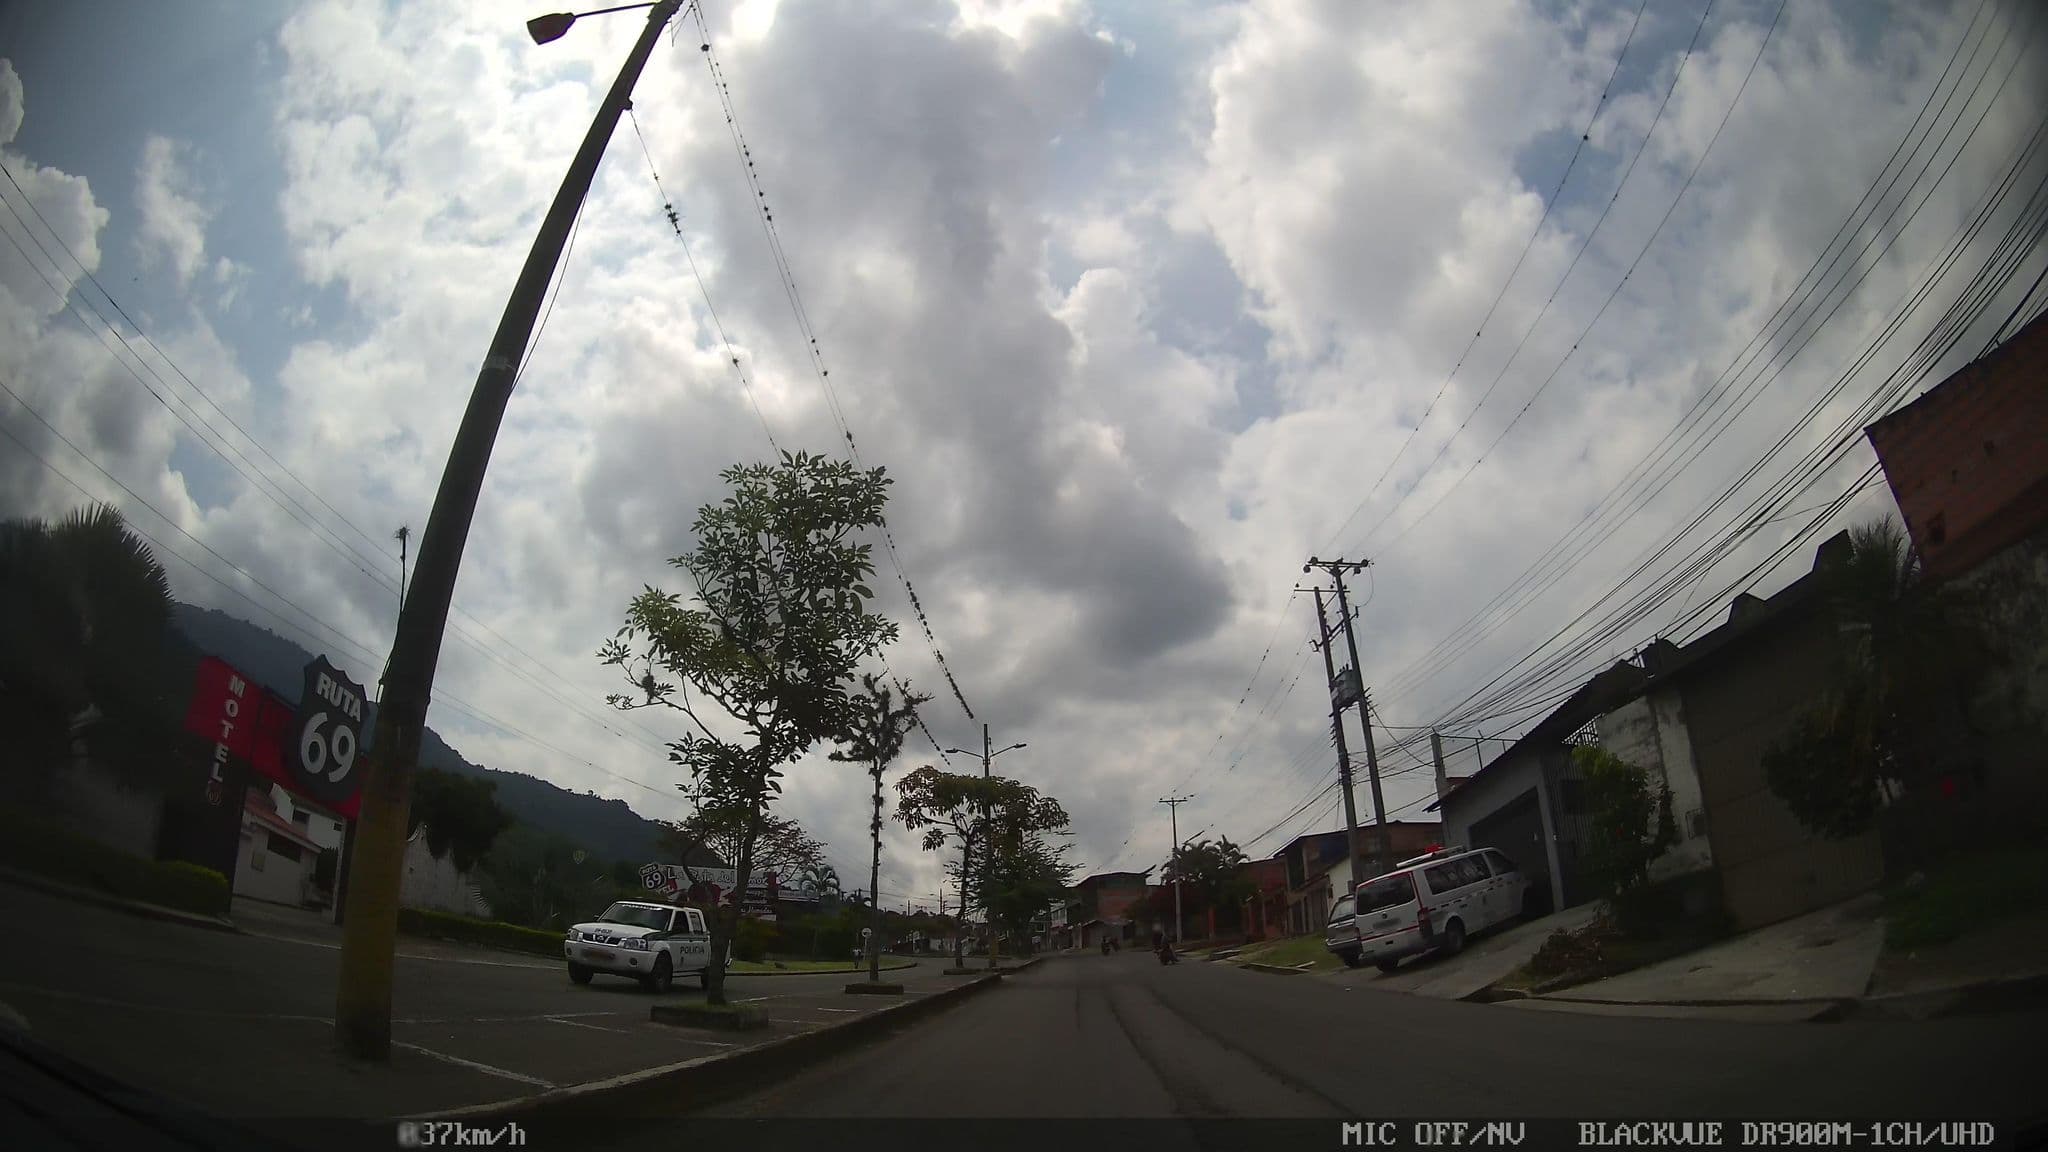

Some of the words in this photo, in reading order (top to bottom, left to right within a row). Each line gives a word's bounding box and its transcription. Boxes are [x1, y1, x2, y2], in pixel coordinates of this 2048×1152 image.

[315, 671, 362, 723] RUTA
[209, 674, 246, 783] MOTEL
[300, 711, 356, 783] 69
[645, 872, 662, 889] 69
[679, 945, 705, 955] POLICIA
